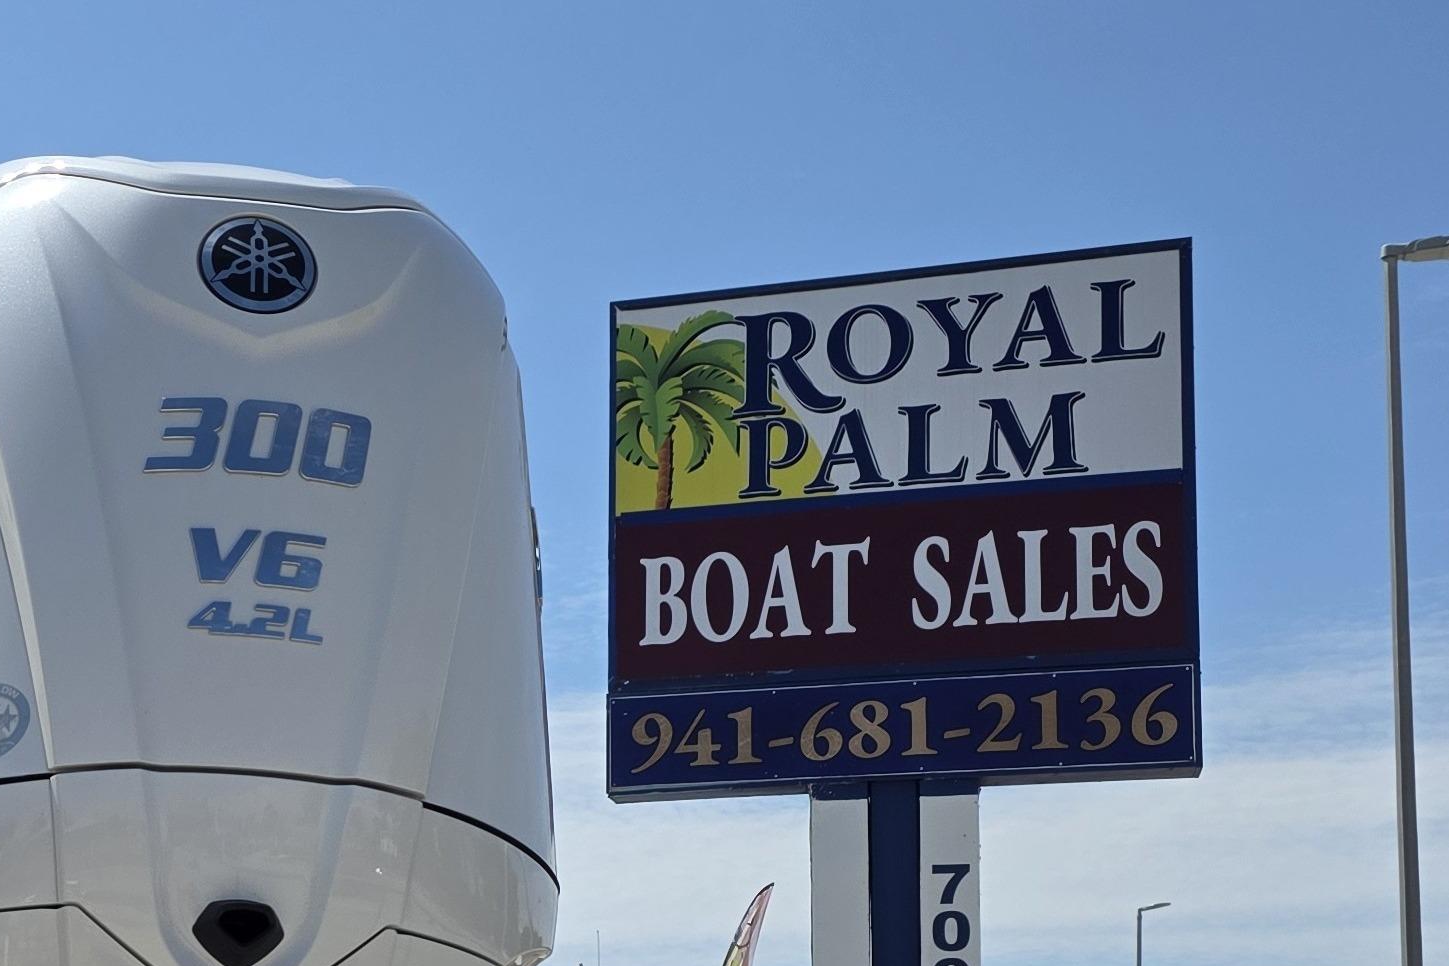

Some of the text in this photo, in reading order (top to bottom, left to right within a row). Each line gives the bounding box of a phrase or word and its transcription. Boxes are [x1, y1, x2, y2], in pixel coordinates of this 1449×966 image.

[732, 278, 1166, 419] ROYAL
[143, 397, 373, 488] 300
[736, 391, 1090, 500] PALM
[189, 527, 327, 592] V6
[639, 519, 1165, 647] BOAT SALES
[187, 601, 324, 646] 4.2L
[631, 683, 1180, 774] 941-681-2136
